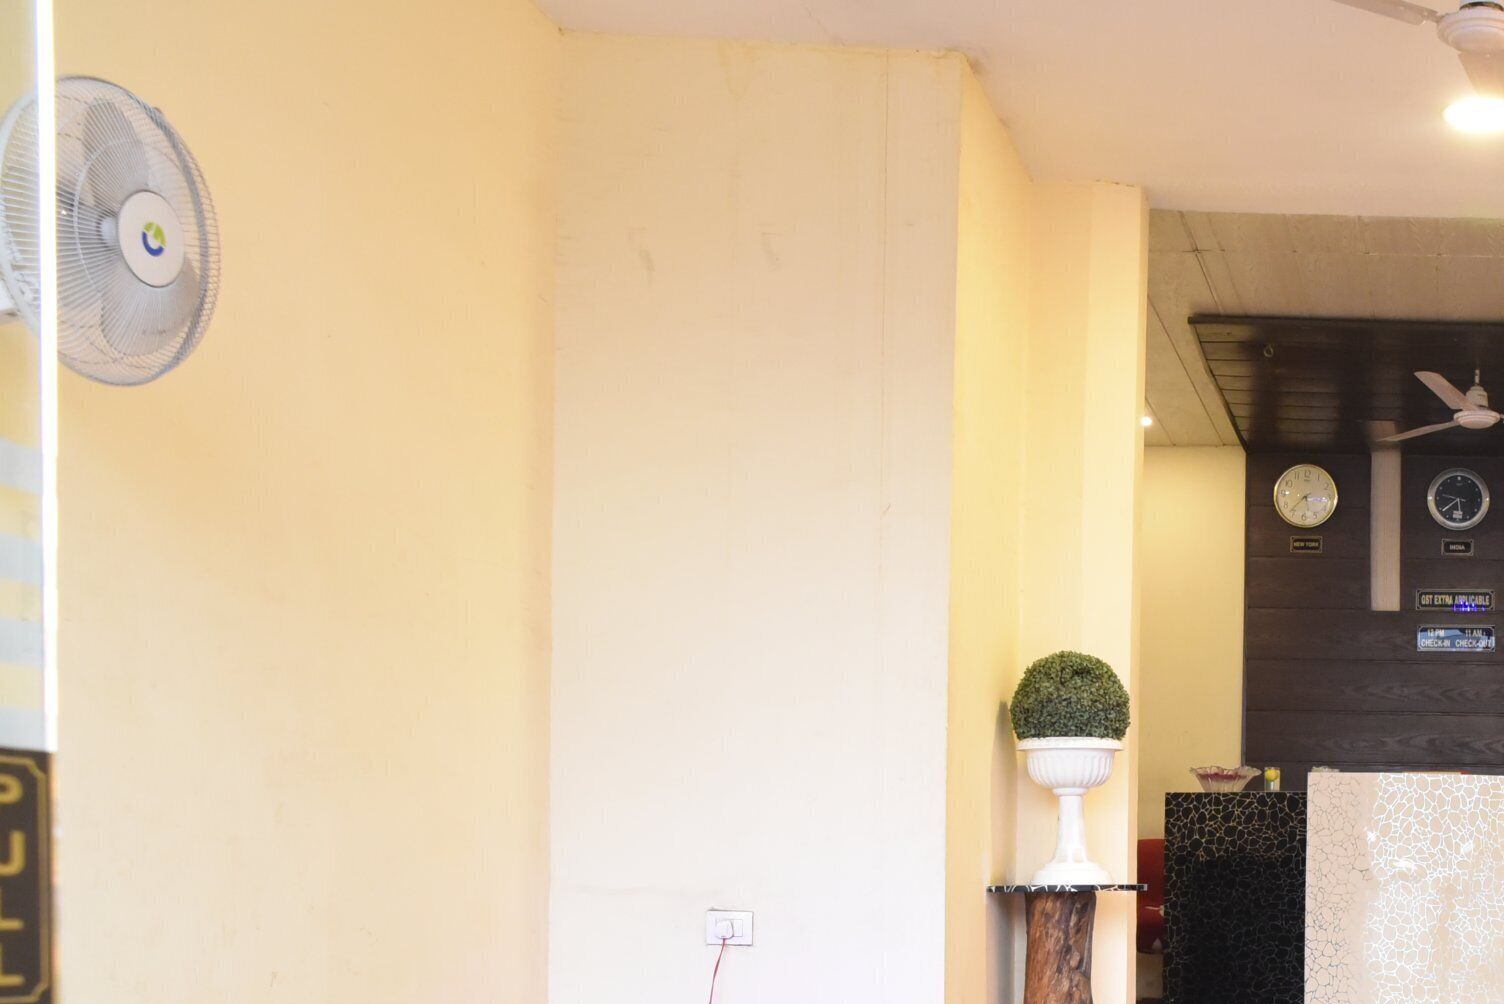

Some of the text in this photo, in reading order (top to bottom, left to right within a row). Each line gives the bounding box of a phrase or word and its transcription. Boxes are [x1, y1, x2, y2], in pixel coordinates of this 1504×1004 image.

[1294, 472, 1300, 480] 11
[1304, 469, 1311, 478] 12
[1323, 482, 1329, 491] 2
[1421, 594, 1490, 606] GST EXTRA APPLICABLE
[1427, 628, 1445, 637] 12 PM
[1421, 639, 1451, 647] CHECK-IN
[1455, 639, 1492, 648] CHECK-OUT
